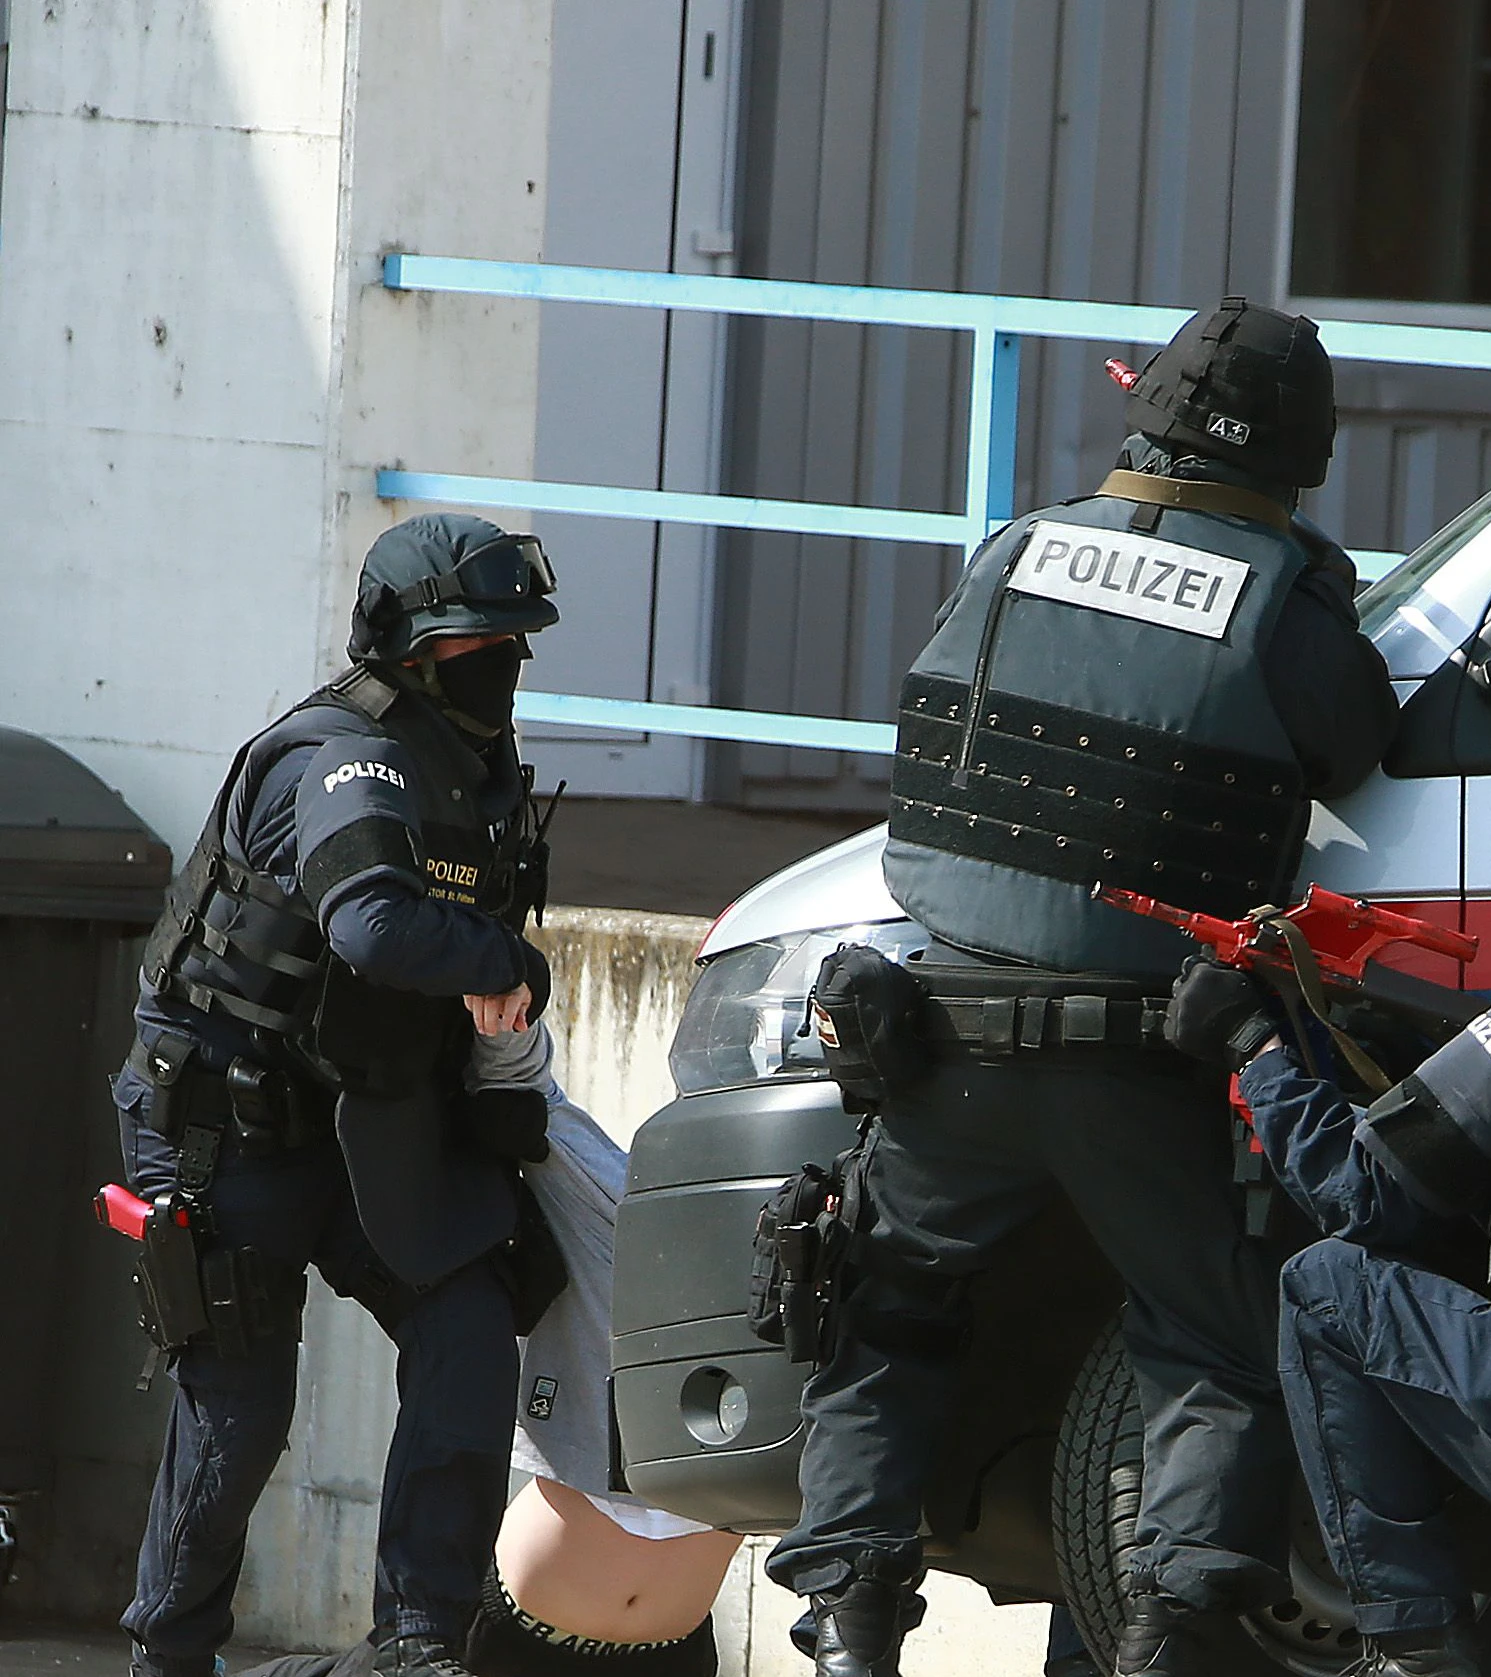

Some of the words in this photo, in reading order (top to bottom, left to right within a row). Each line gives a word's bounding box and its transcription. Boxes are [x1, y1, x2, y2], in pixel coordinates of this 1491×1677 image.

[1034, 539, 1224, 613] POLIZEI
[323, 761, 405, 794] POLIZEI
[426, 858, 479, 887] POLIZEI
